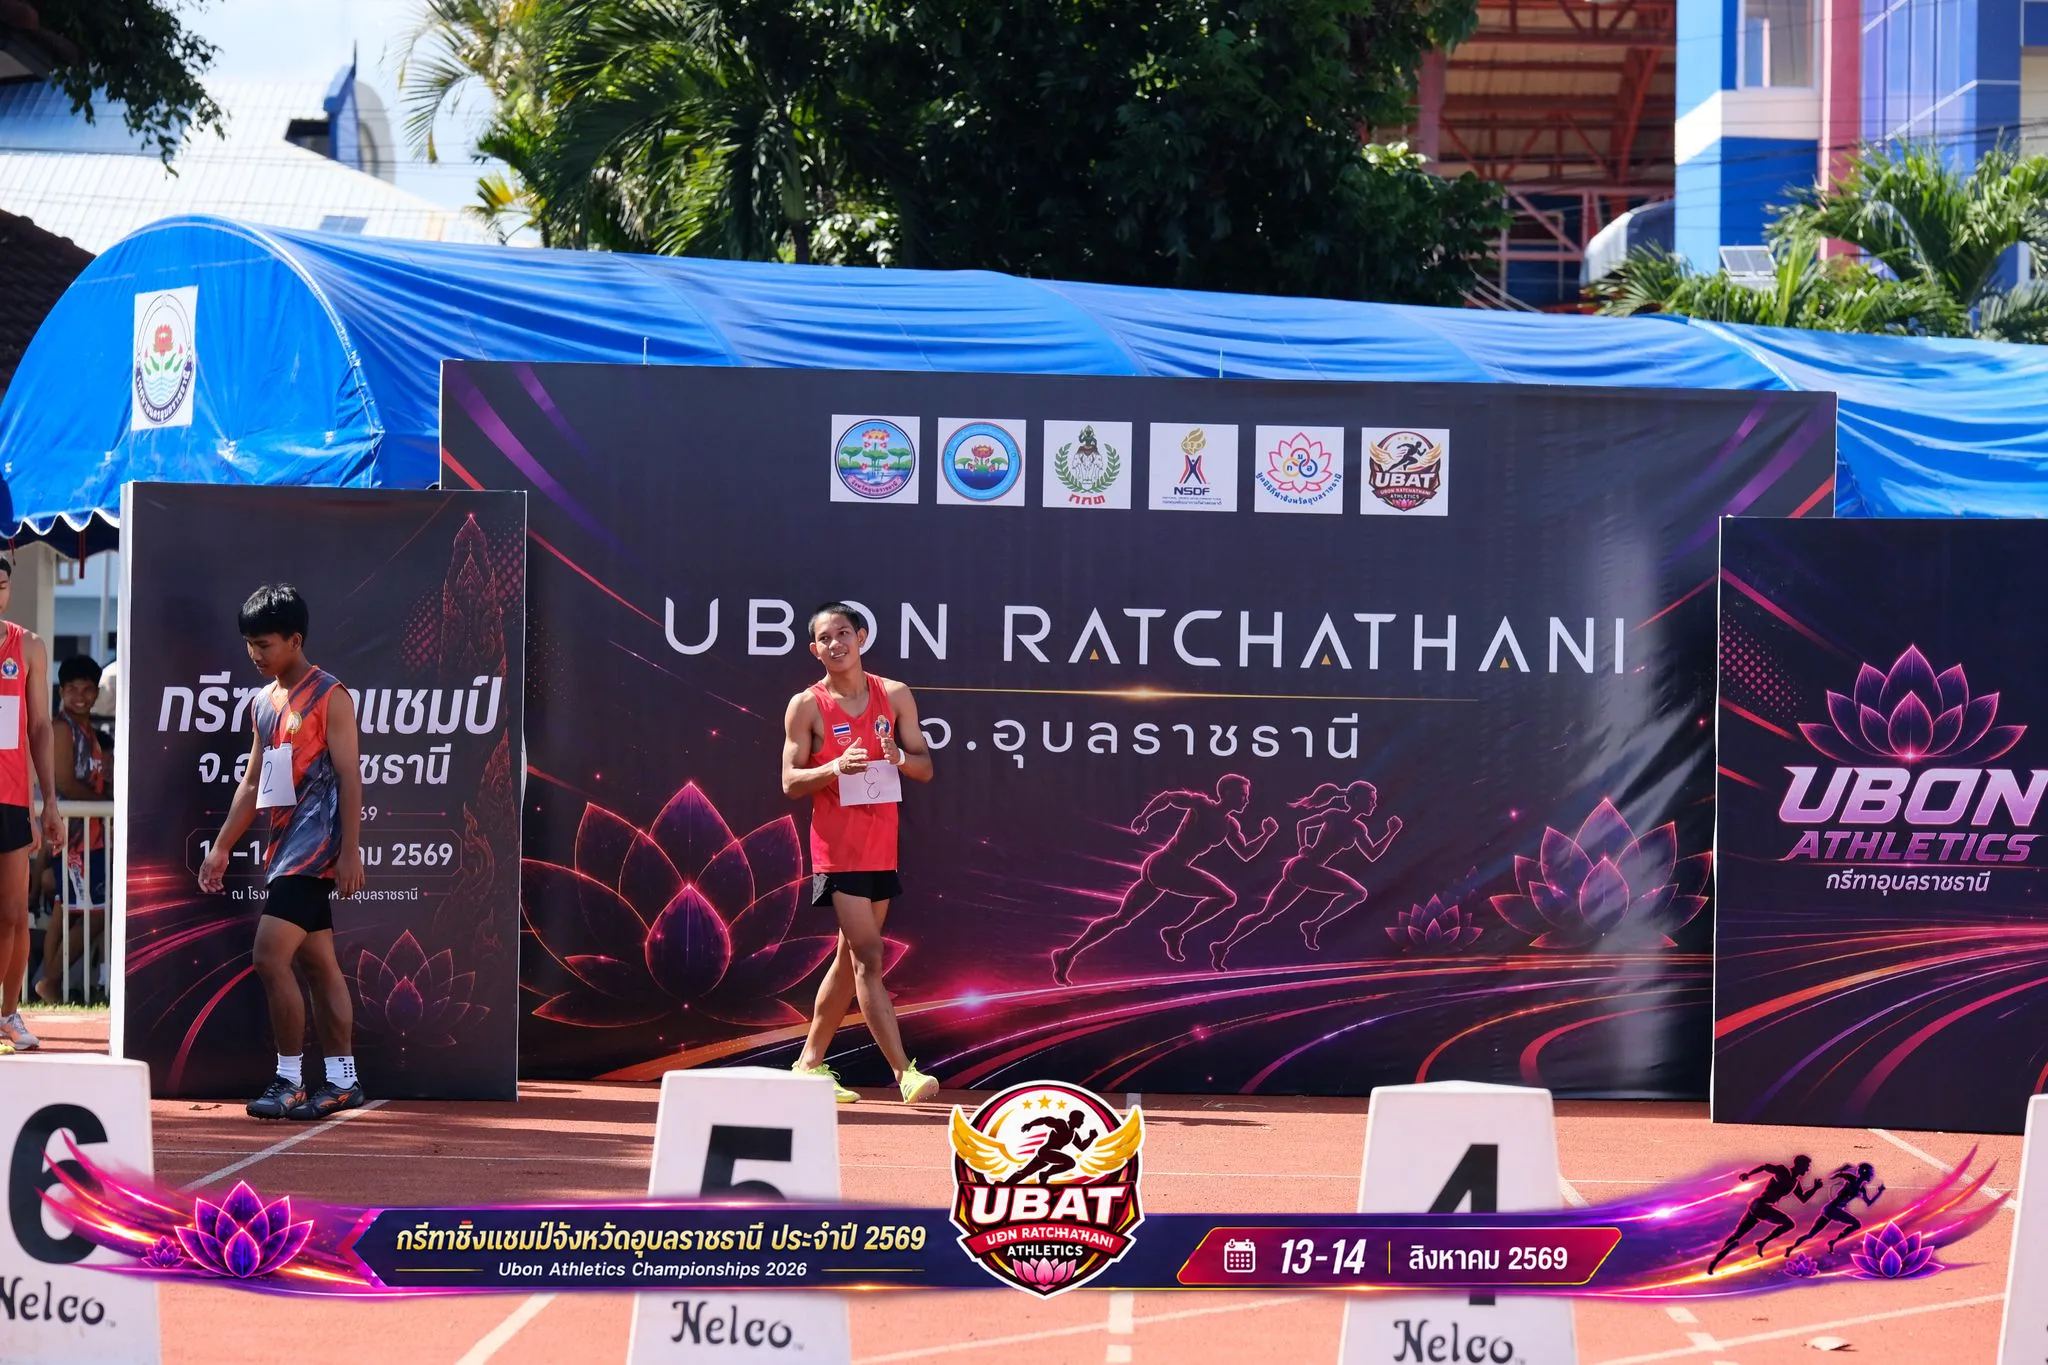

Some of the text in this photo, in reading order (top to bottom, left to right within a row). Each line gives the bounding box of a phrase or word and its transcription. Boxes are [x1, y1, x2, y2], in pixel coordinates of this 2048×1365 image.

[1174, 486, 1211, 496] NSDF
[1375, 472, 1435, 489] UBAT
[1003, 605, 1624, 674] RATCHATHANI
[262, 760, 273, 795] 2
[1779, 766, 2048, 827] UBON
[391, 843, 453, 866] 2569
[1780, 830, 2037, 863] ATHLETICS
[9, 1103, 108, 1264] 6
[671, 1300, 793, 1349] Nelco
[1393, 1318, 1514, 1364] Nelco
